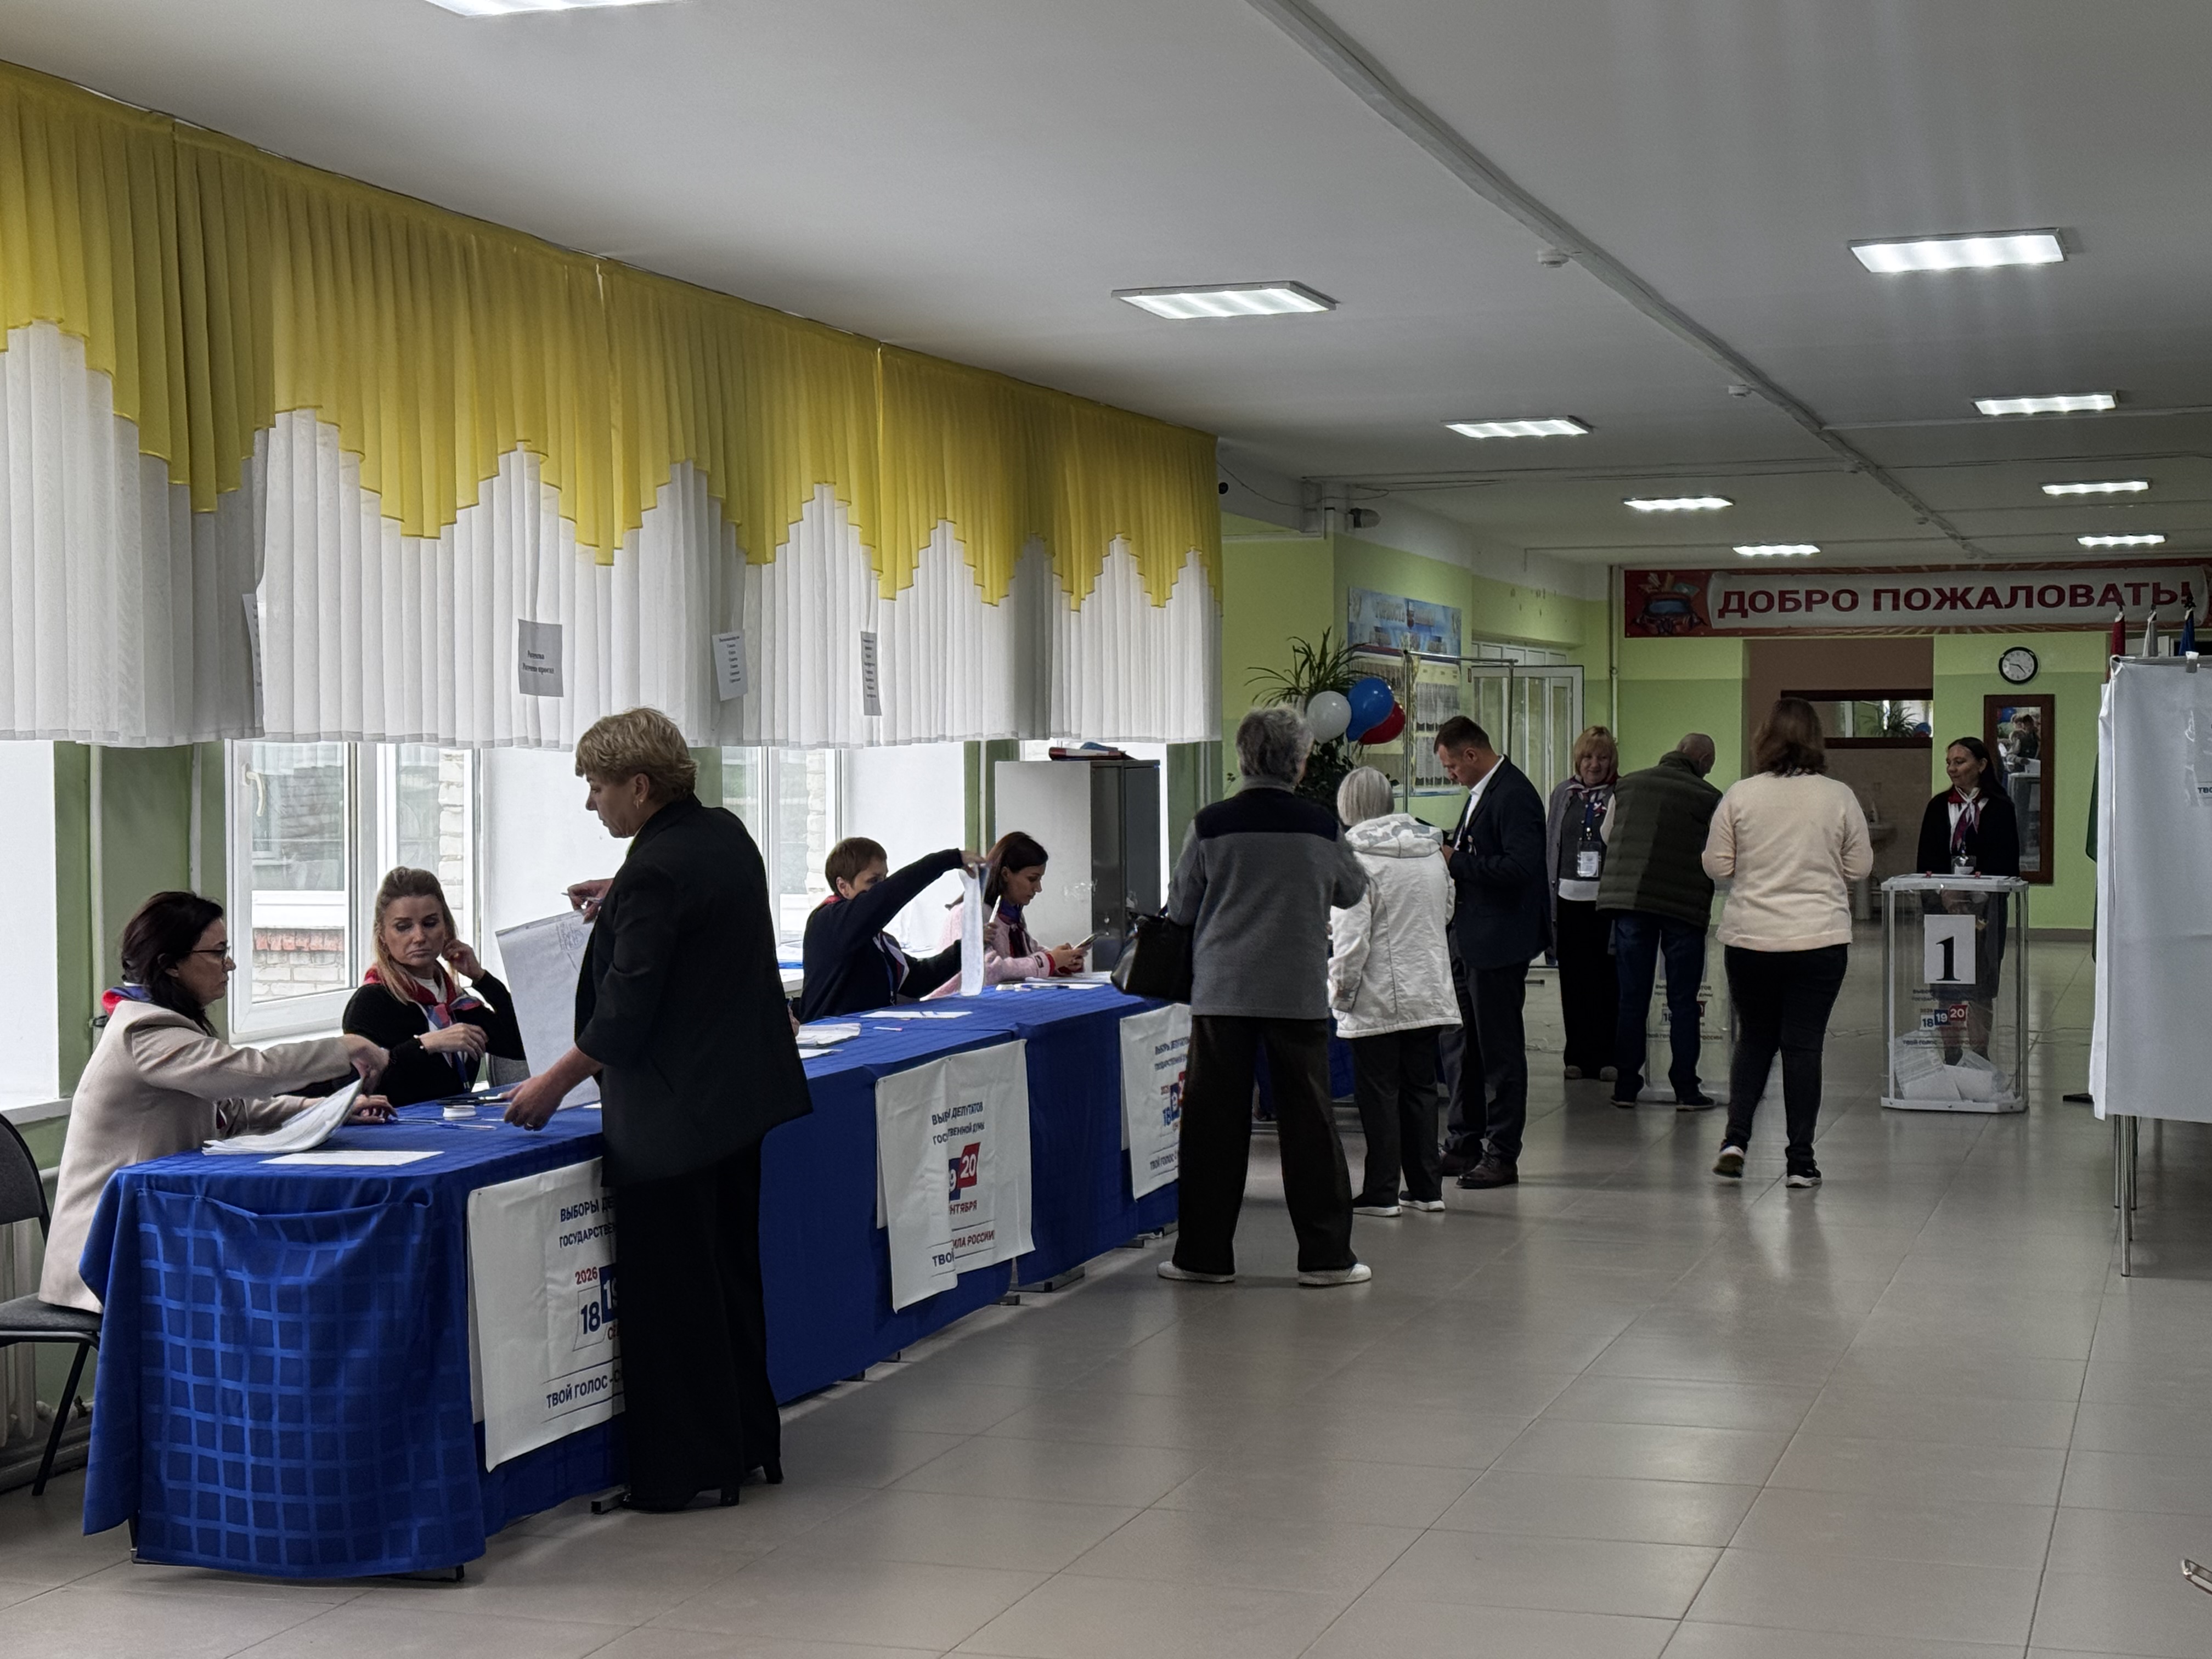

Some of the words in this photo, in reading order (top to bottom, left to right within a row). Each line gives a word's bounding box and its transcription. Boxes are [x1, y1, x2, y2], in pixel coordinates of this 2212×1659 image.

[1718, 589, 1859, 619] ДОБРО
[1873, 581, 2191, 612] ПОЖАЛОВАТЬ!
[1936, 936, 1961, 981] 1
[1922, 1018, 1934, 1028] 18
[1936, 1013, 1947, 1023] 19
[1950, 1008, 1965, 1018] 20
[960, 1154, 977, 1178] 20
[560, 1199, 600, 1222] ВЫБОРЫ
[950, 1200, 977, 1215] НТЯБРЯ
[560, 1222, 615, 1249] ГОСУДАРСТВЕ
[575, 1266, 598, 1285] 2026
[580, 1301, 601, 1334] 18
[546, 1384, 572, 1409] ТВОЙ
[574, 1375, 608, 1398] ГОЛОС
